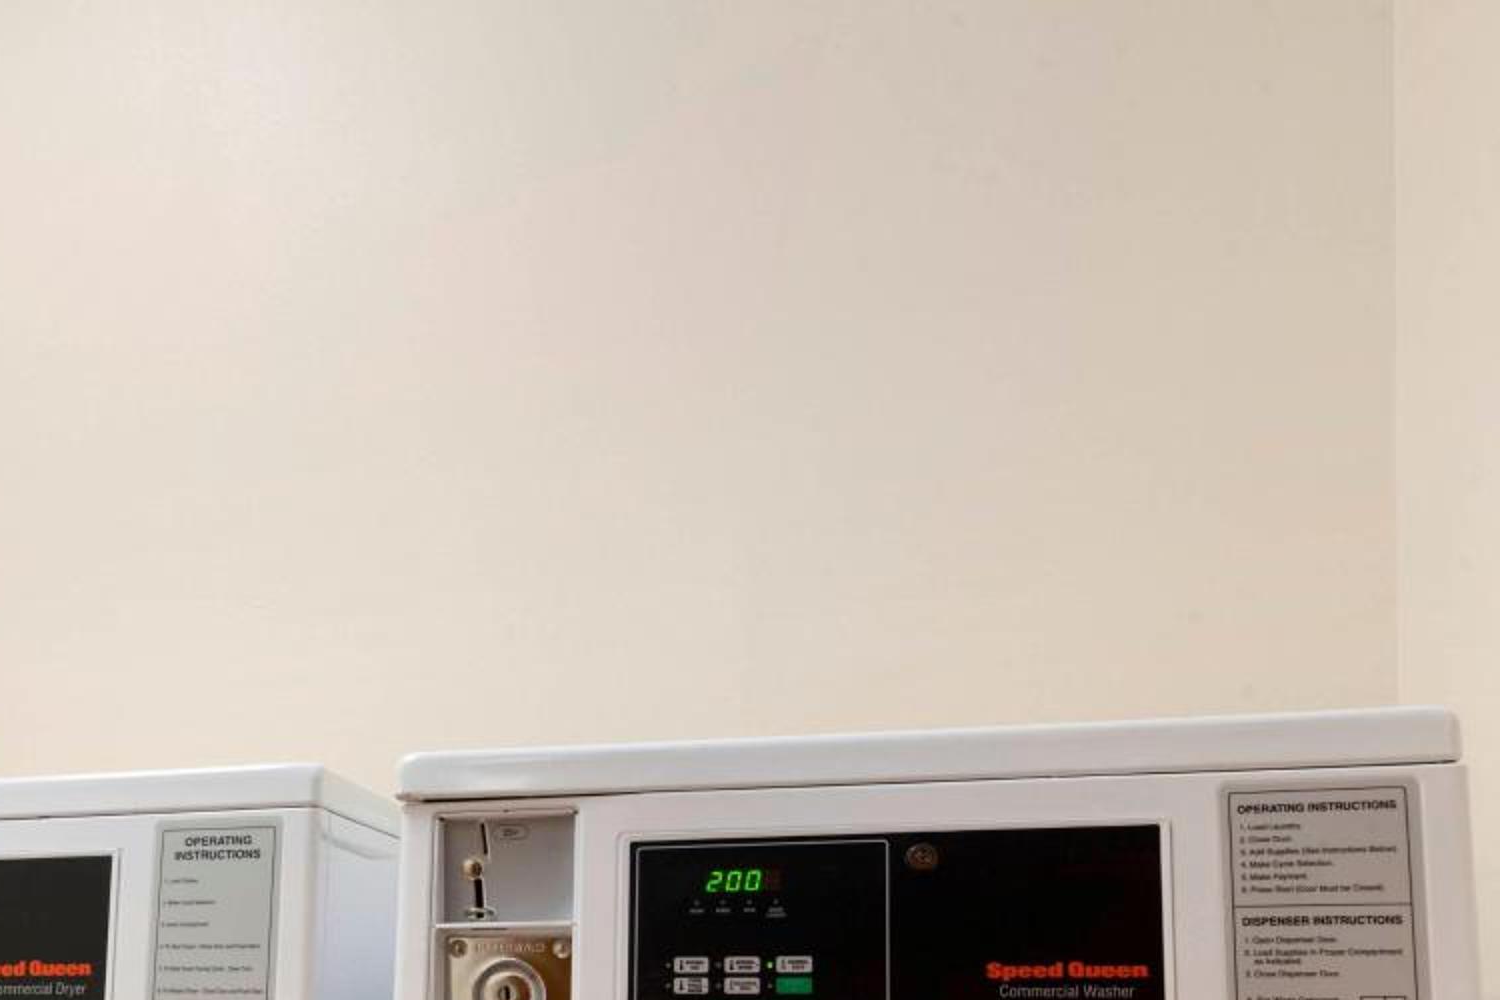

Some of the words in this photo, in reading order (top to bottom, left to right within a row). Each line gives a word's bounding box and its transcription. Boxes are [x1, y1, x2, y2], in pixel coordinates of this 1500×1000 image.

[1237, 803, 1304, 814] OPERATING
[1307, 800, 1397, 812] INSTRUCTIONS
[185, 835, 252, 847] OPERATING
[174, 849, 260, 861] INSTRUCTIONS
[706, 869, 762, 892] 200
[1242, 915, 1310, 927] DISPENSER
[1313, 915, 1403, 926] INSTRUCTIONS
[29, 960, 92, 977] Queen
[985, 962, 1064, 982] Speed
[1068, 961, 1148, 979] Queen
[55, 982, 85, 997] Dryer
[999, 984, 1079, 999] Commercial
[1083, 984, 1134, 999] Washer
